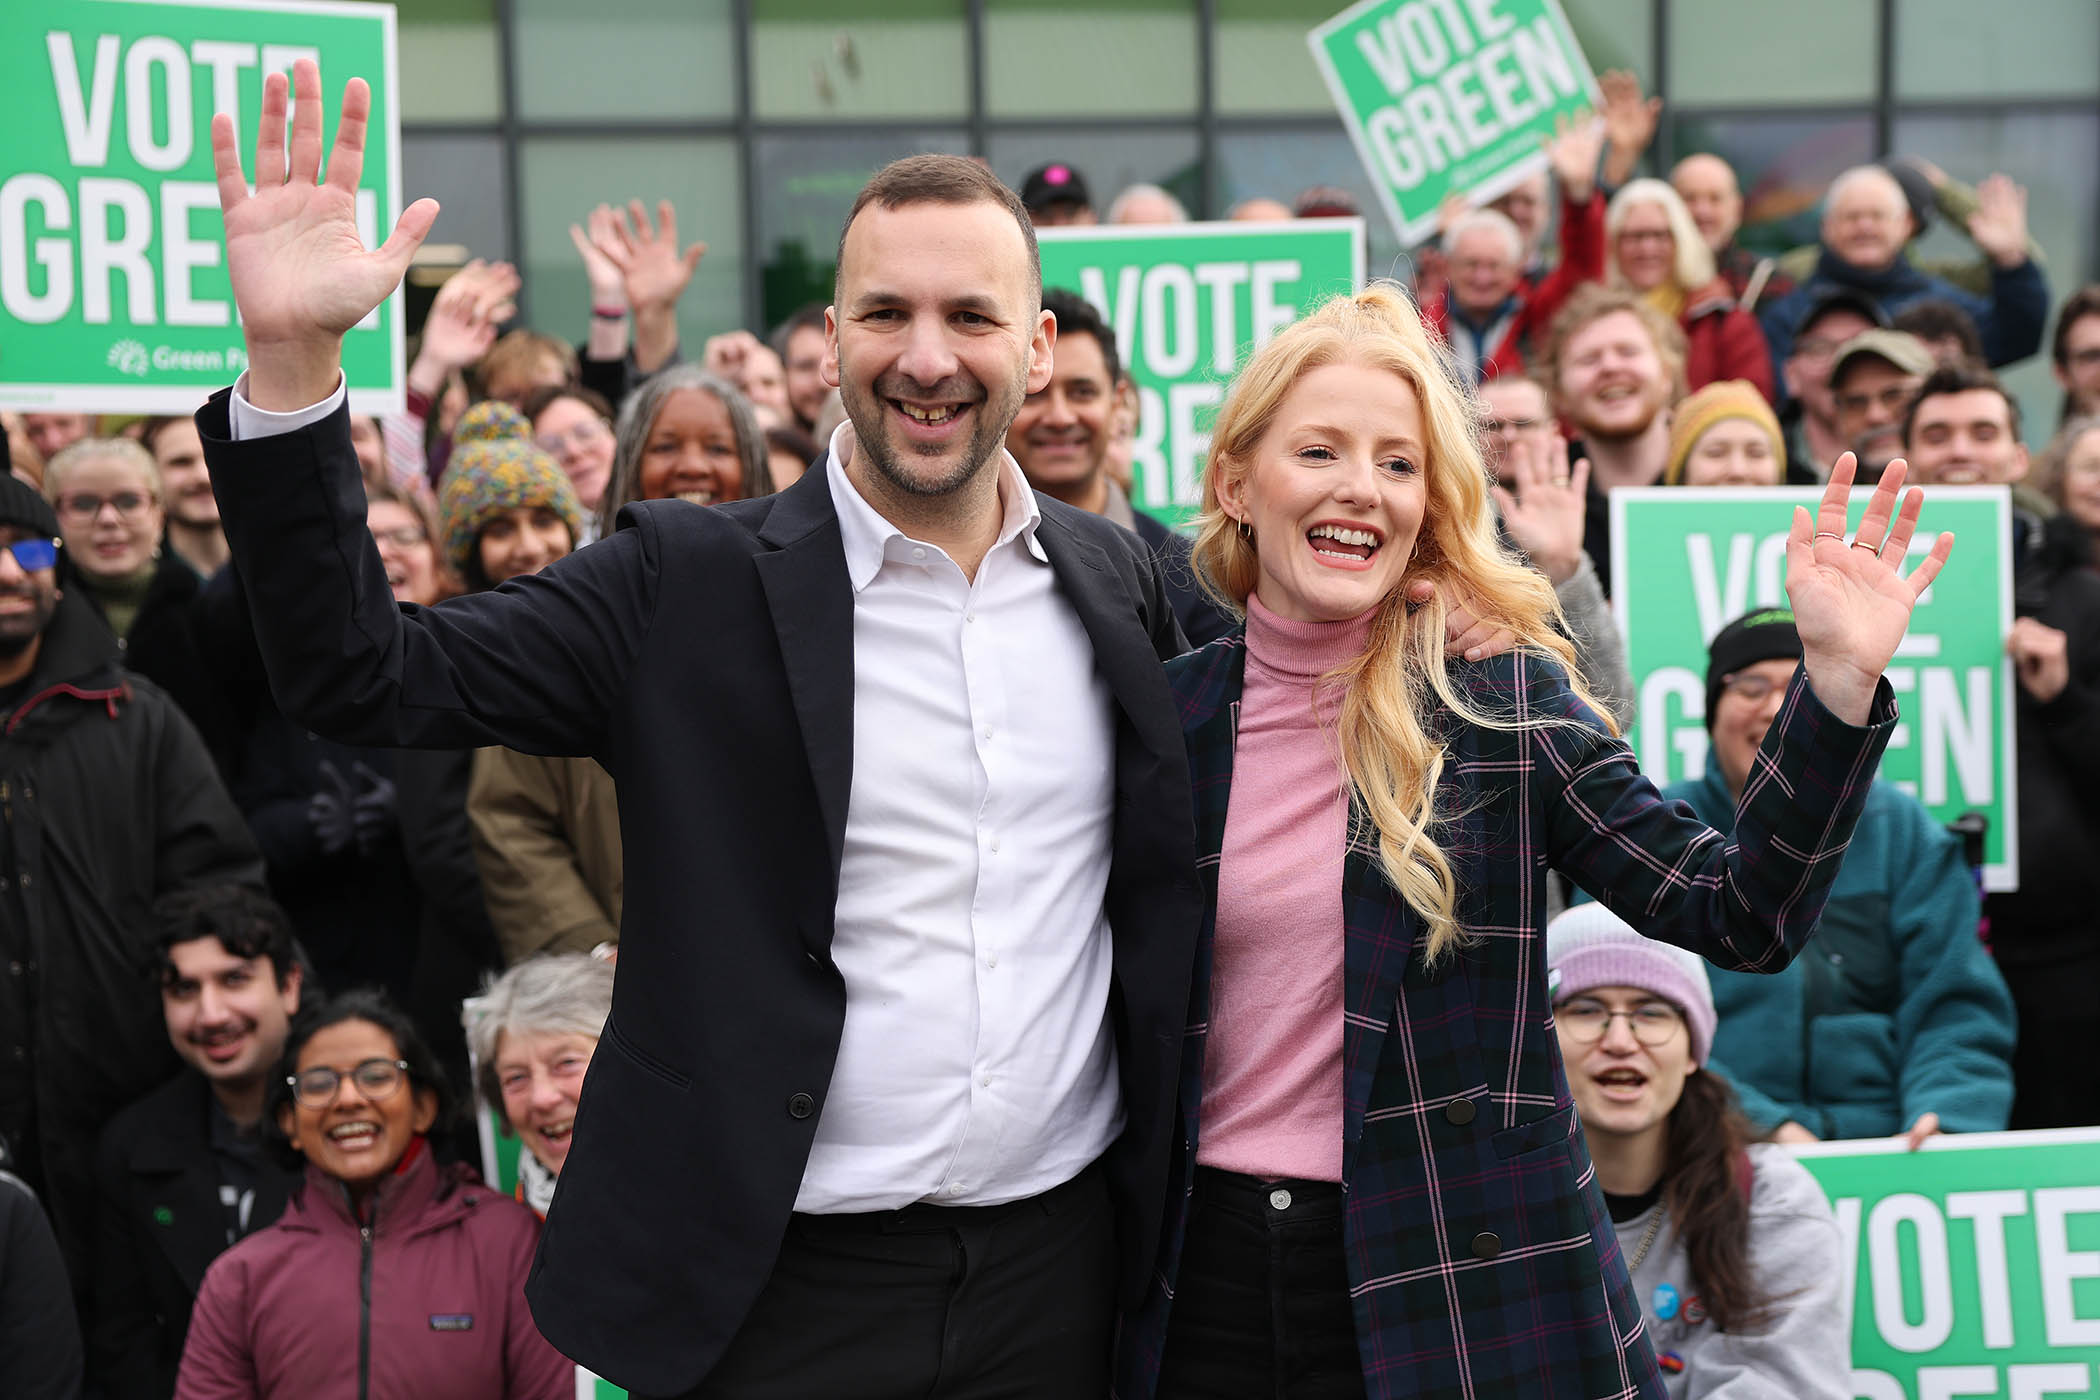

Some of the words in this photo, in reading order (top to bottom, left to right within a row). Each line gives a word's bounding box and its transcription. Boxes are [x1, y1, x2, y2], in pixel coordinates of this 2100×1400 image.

[1355, 0, 1518, 98] VOTE
[1366, 16, 1579, 191] GREEN
[0, 172, 381, 331] GRE
[152, 345, 224, 371] Green
[1079, 260, 1302, 378] VOTE
